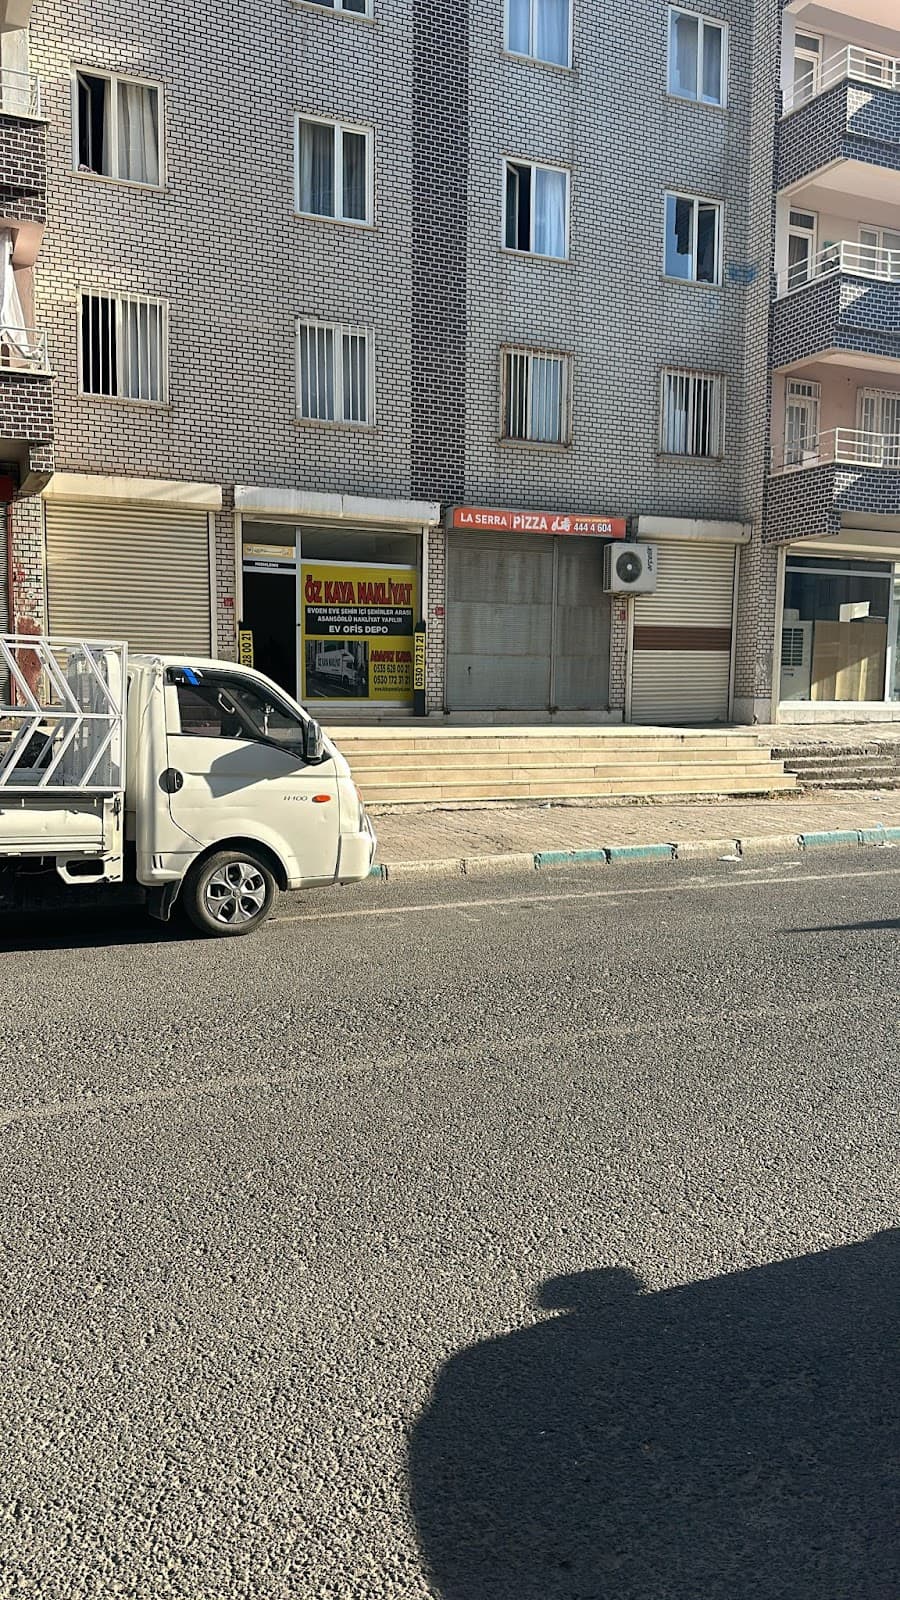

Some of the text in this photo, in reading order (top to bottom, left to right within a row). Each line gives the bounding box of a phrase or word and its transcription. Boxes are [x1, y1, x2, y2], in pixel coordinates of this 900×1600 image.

[460, 512, 507, 526] LA SERRA
[573, 522, 612, 533] 444 4 604
[305, 575, 412, 605] ÖZ KAYA NAKLİYAT
[329, 624, 388, 634] EV OFİS DEPO
[241, 633, 251, 641] 21
[415, 635, 424, 643] 21
[242, 643, 252, 653] 00
[415, 667, 424, 687] 0530
